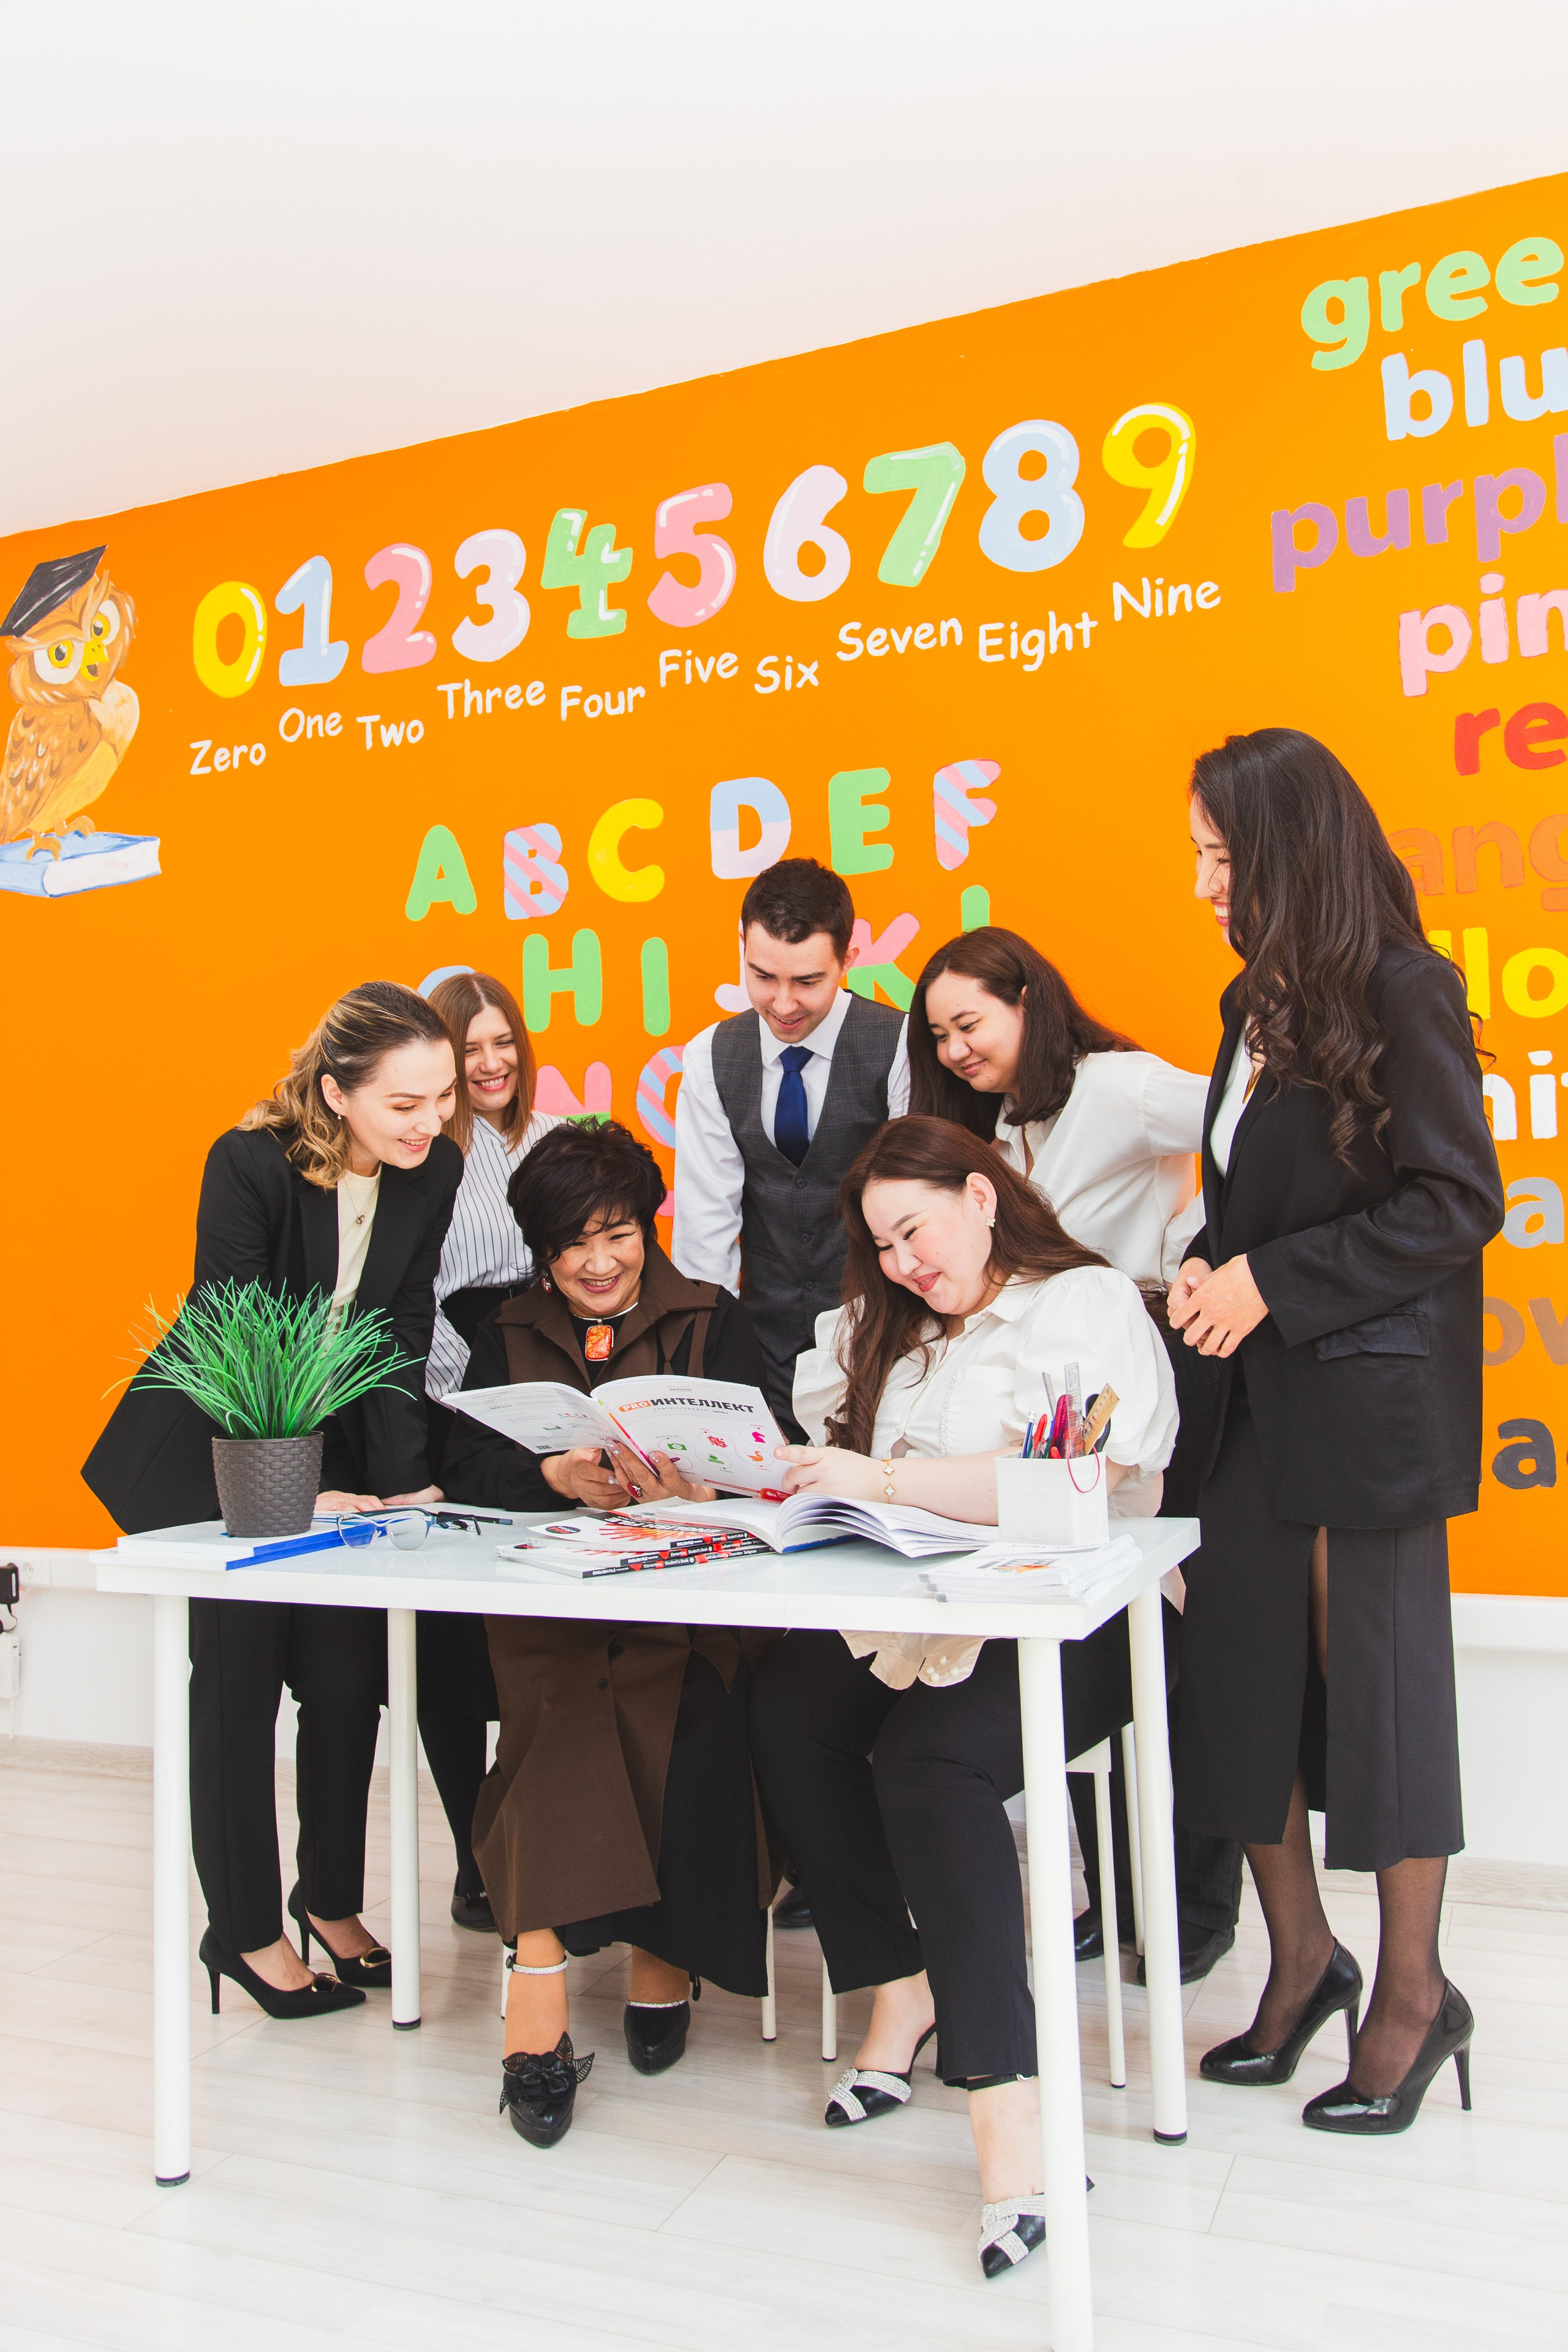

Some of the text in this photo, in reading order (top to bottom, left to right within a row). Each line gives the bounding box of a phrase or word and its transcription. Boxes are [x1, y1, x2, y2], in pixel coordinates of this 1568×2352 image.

[194, 402, 1196, 698] 0 1 2 3 4 5 6 7 8 9
[190, 577, 1221, 775] Zero One Two Three Four Five Six Seven Eight Nine
[405, 758, 1001, 921] A B C D E F
[522, 929, 602, 1033] H
[641, 937, 670, 1036] I
